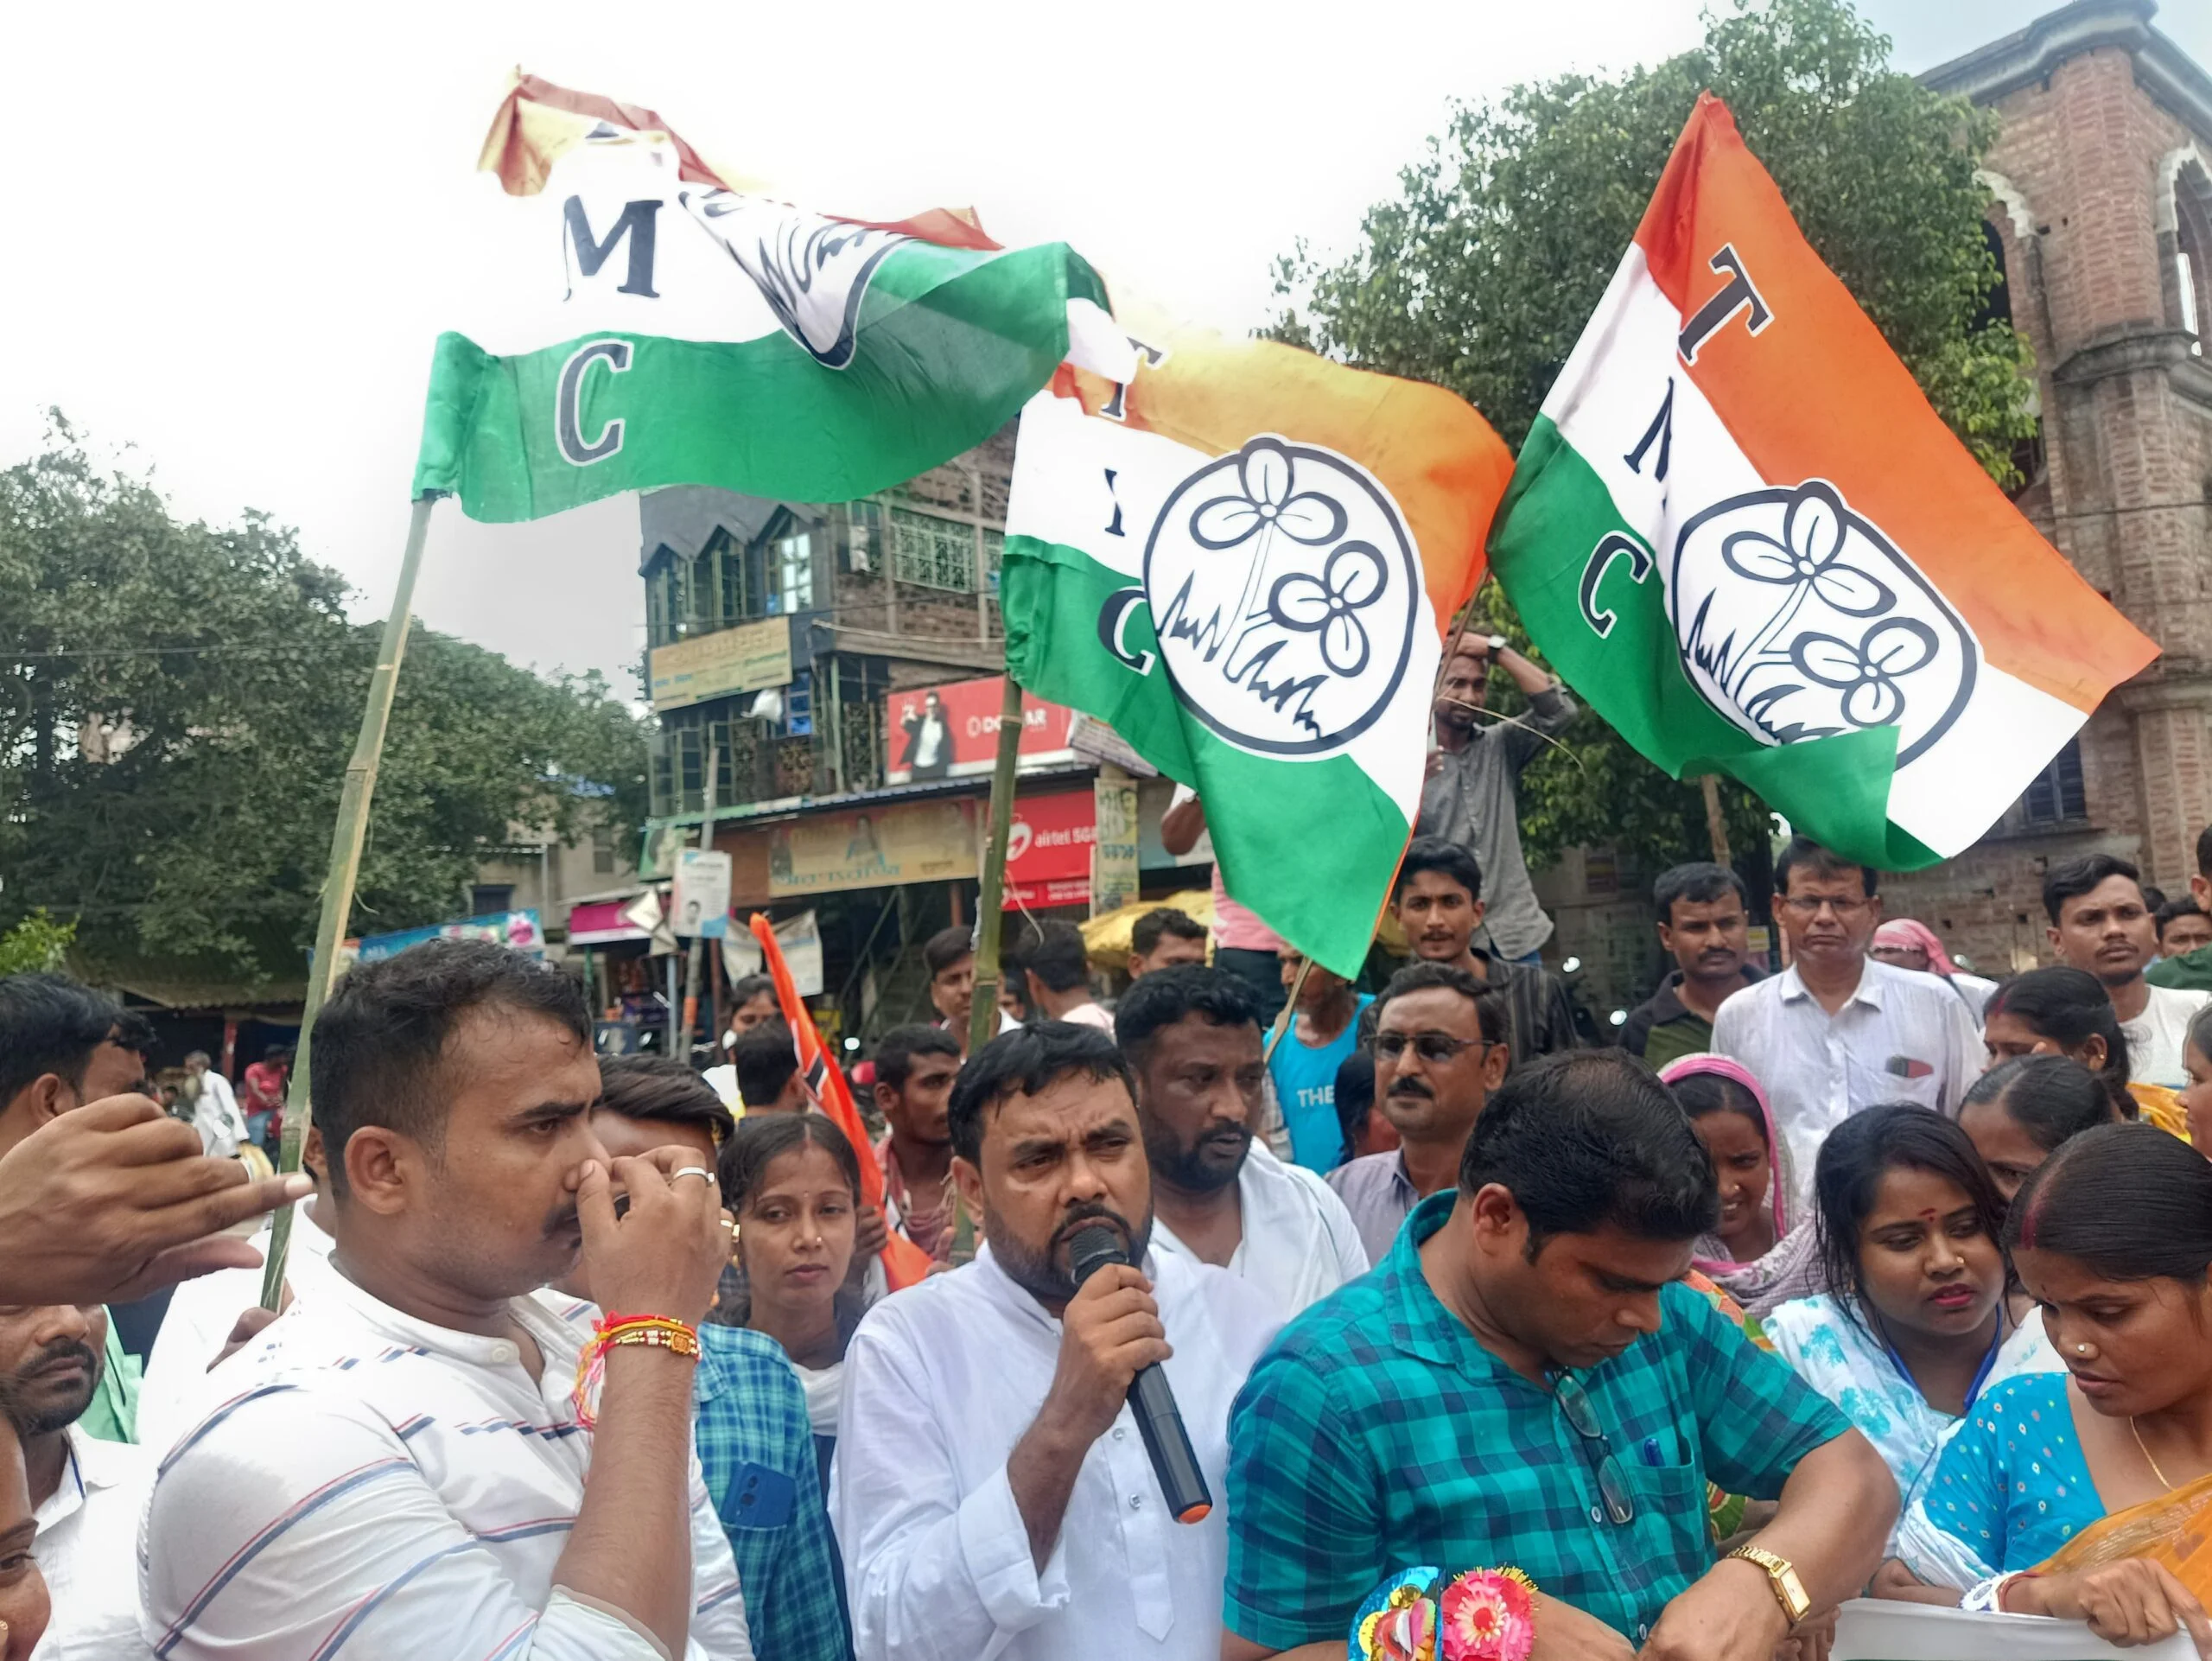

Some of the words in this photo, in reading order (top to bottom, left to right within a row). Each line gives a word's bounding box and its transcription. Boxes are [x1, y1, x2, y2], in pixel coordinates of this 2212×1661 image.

[982, 708, 1046, 733] DOAR
[1035, 829, 1071, 848] airtel
[1297, 1085, 1335, 1108] THE
